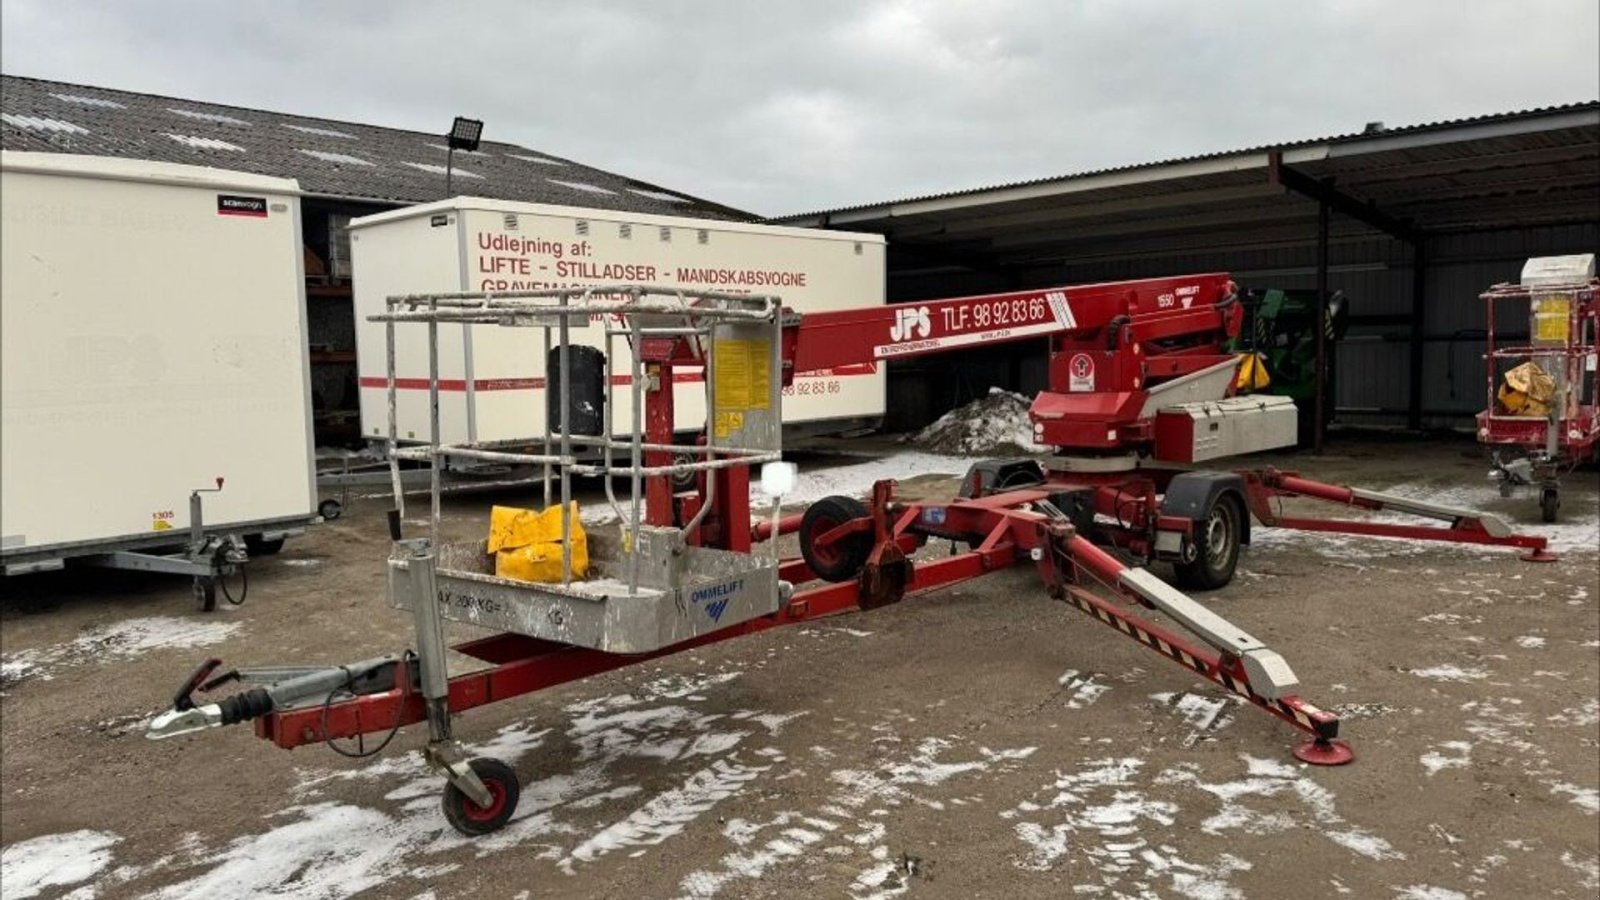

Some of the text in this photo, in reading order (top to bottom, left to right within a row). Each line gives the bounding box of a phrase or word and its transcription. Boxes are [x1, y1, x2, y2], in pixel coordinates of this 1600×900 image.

[478, 231, 592, 258] Udlejning af:
[480, 255, 531, 275] LIFTE
[556, 260, 656, 281] STILLADSER
[677, 267, 806, 287] MANDSKABSVOGNE
[890, 306, 932, 342] JPS
[941, 297, 1046, 330] TLF. 98 92 83 66
[797, 382, 811, 395] 92
[812, 381, 825, 394] 83
[828, 380, 840, 393] 66
[692, 579, 744, 603] OMMELIFT
